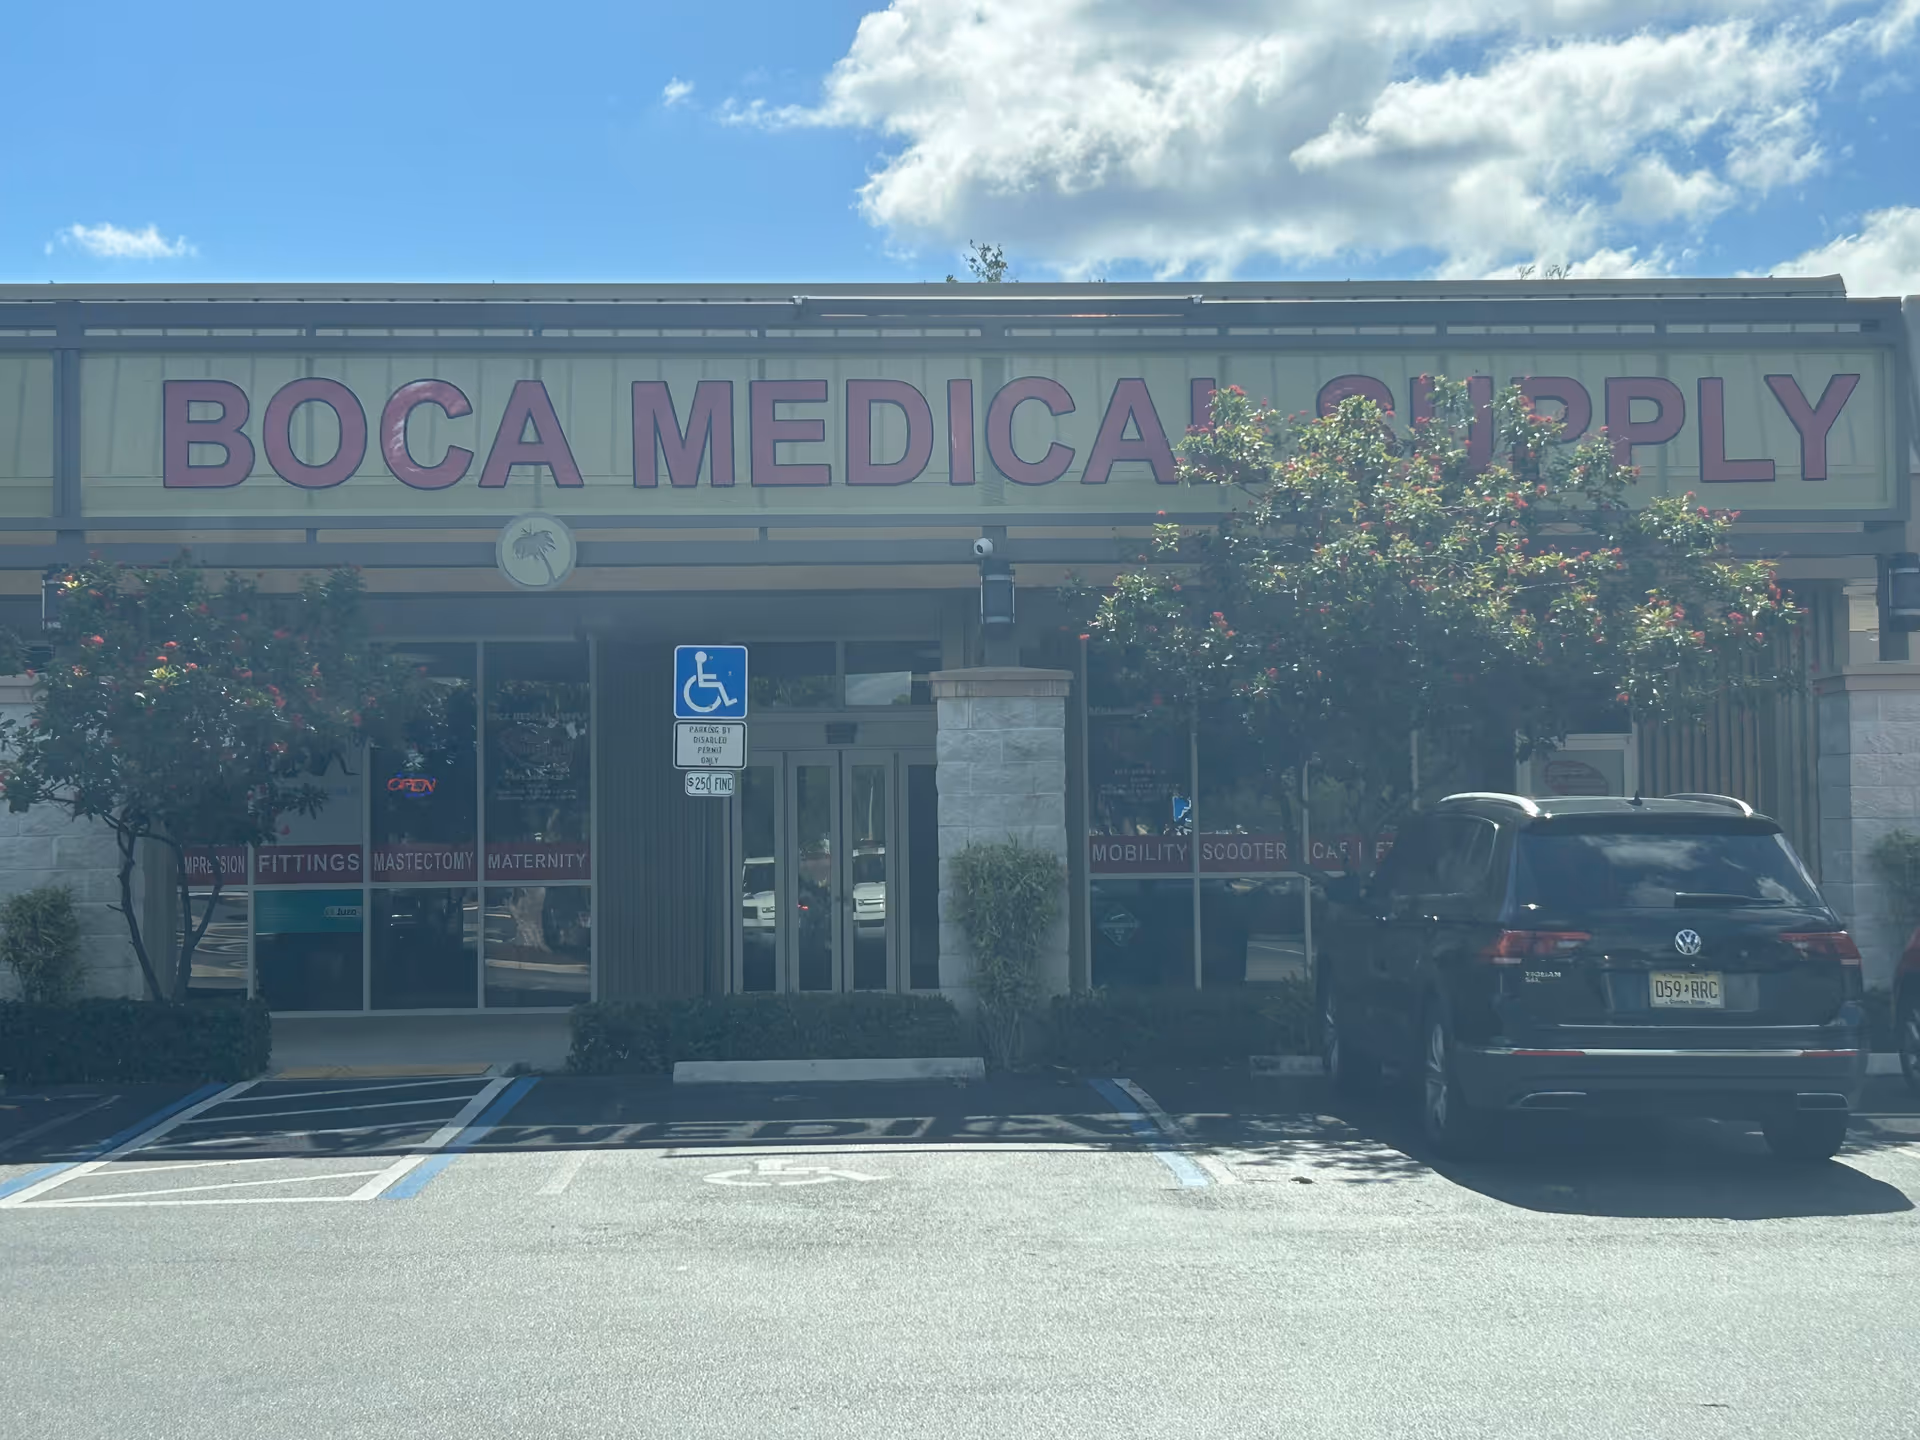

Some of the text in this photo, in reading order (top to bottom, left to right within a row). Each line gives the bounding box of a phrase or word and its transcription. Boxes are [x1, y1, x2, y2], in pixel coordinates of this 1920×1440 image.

[163, 377, 584, 490] BOCA
[631, 376, 1267, 488] MEDICAL
[689, 726, 731, 734] PARKING BY
[693, 736, 728, 744] DISABLED
[697, 746, 722, 754] PERMIT
[700, 756, 719, 764] ONLY
[387, 777, 436, 792] OPEN
[714, 777, 732, 791] FINE
[1092, 843, 1188, 862] MOBILITY
[1202, 842, 1288, 860] SCOOTER
[258, 853, 361, 873] FITTINGS
[373, 851, 474, 871] MASTECTOMY
[488, 852, 586, 869] MATERNITY
